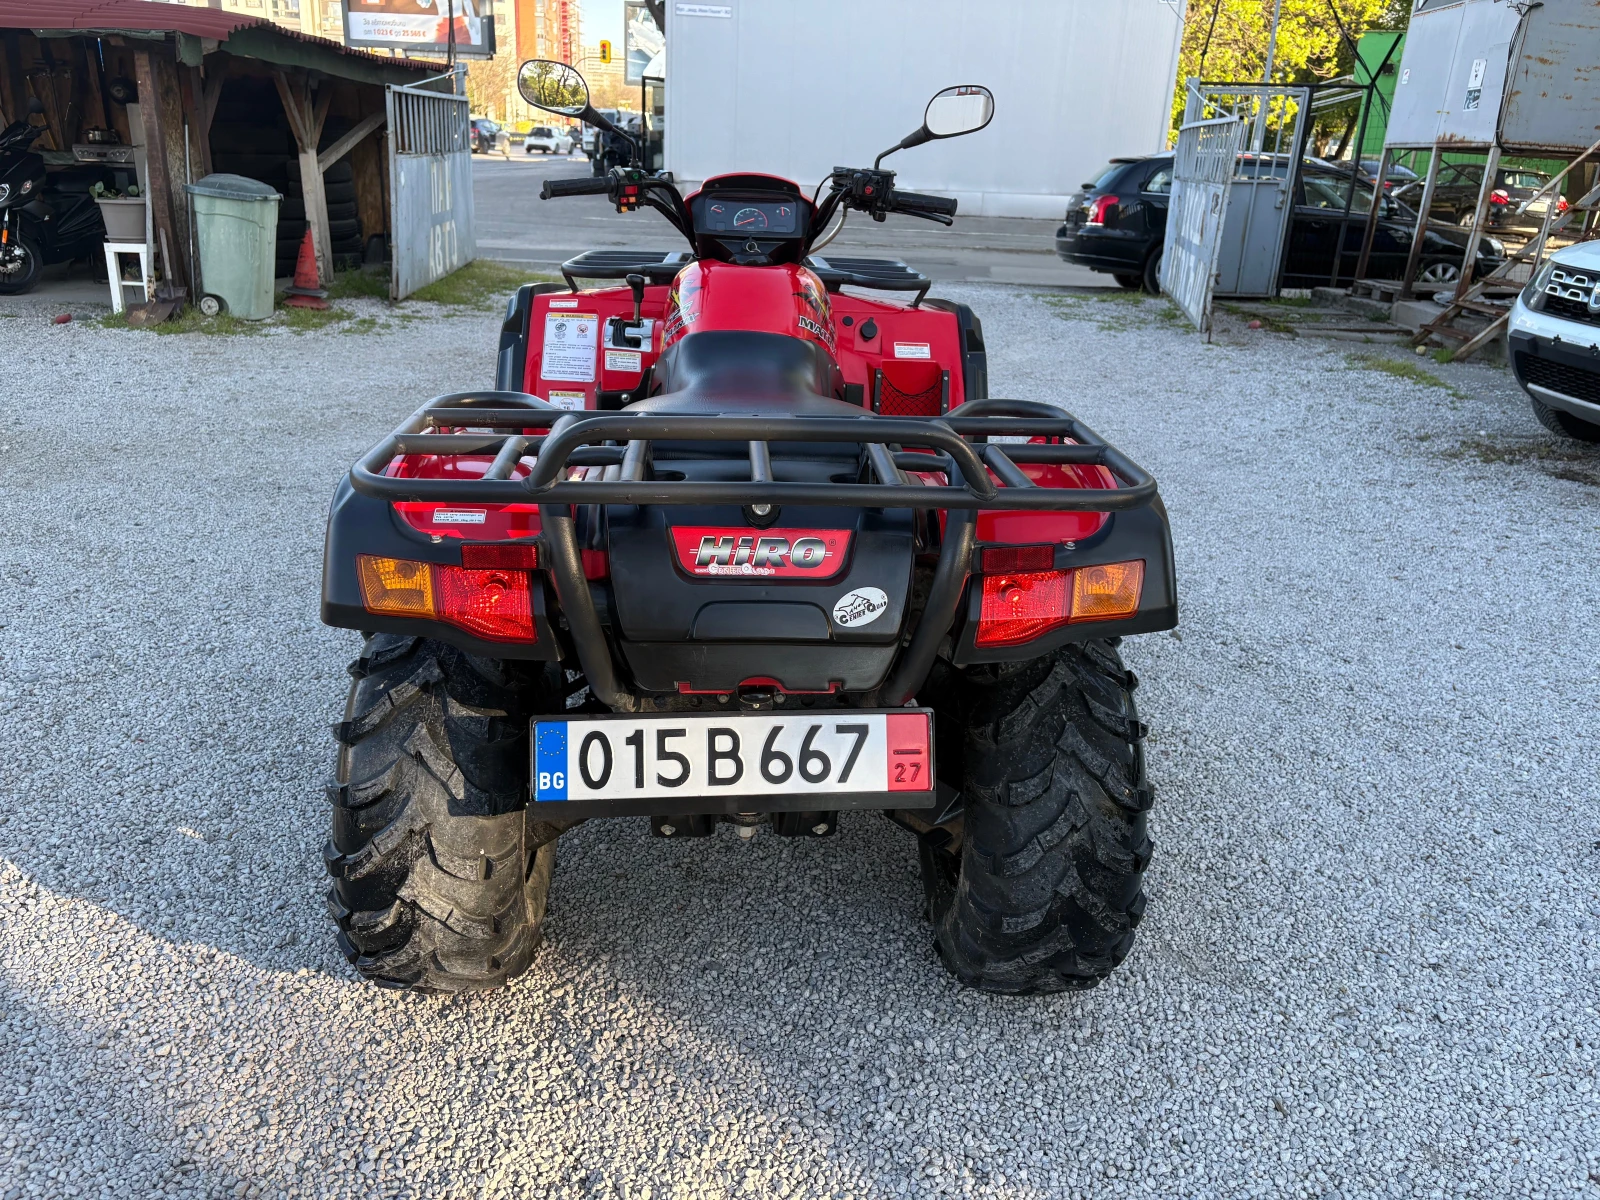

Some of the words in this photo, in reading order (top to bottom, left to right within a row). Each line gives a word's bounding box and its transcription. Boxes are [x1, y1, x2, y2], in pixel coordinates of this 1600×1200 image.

[363, 18, 370, 26] За
[371, 19, 407, 27] автомобили
[539, 771, 565, 790] BG
[894, 762, 921, 784] 27
